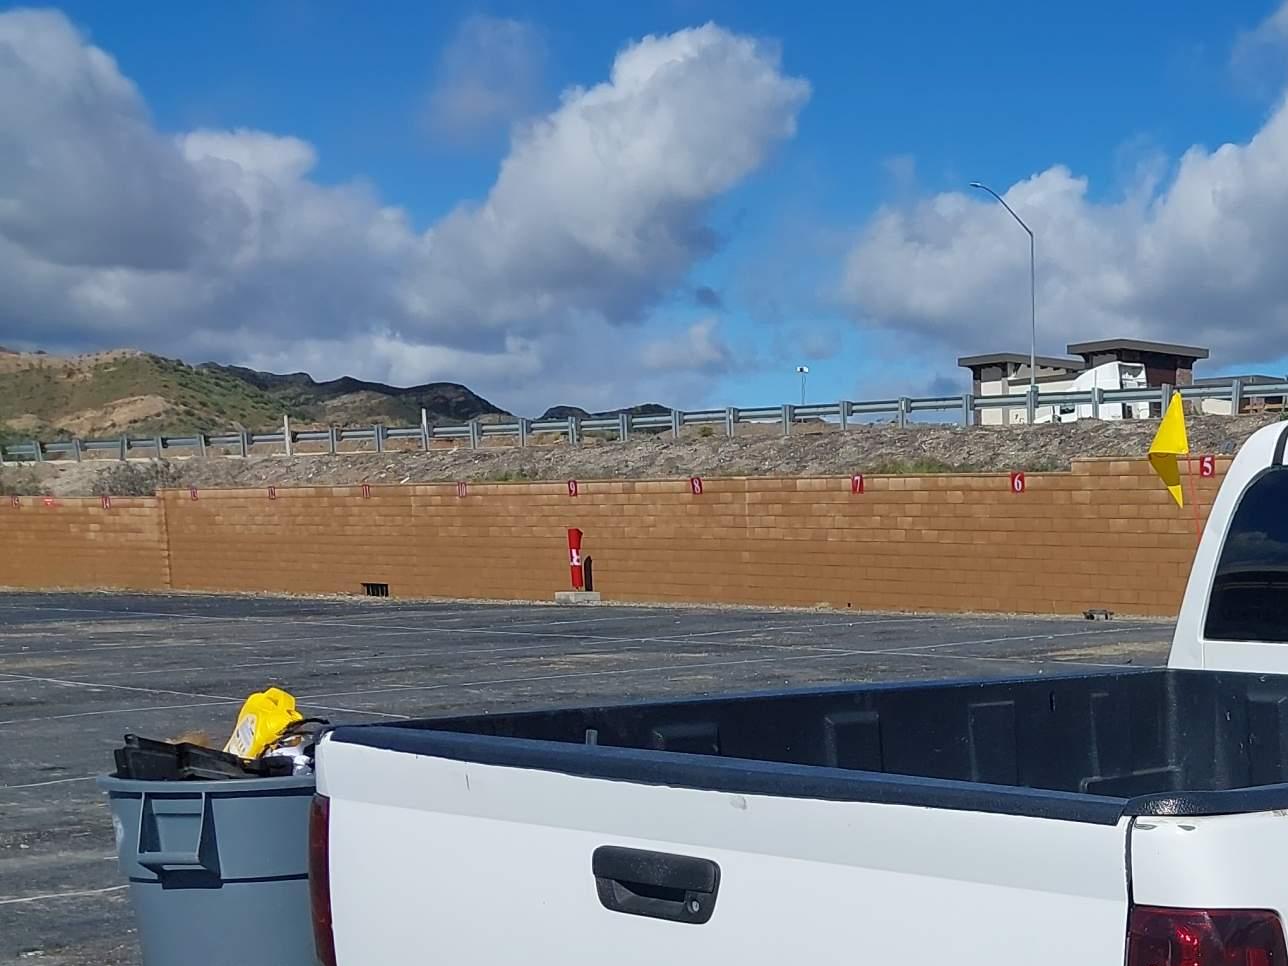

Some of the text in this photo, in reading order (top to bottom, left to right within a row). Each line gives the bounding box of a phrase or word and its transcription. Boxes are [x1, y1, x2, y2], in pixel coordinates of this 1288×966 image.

[1203, 456, 1212, 476] 5
[694, 478, 701, 493] 8
[854, 476, 861, 493] 7
[1014, 473, 1022, 491] 6
